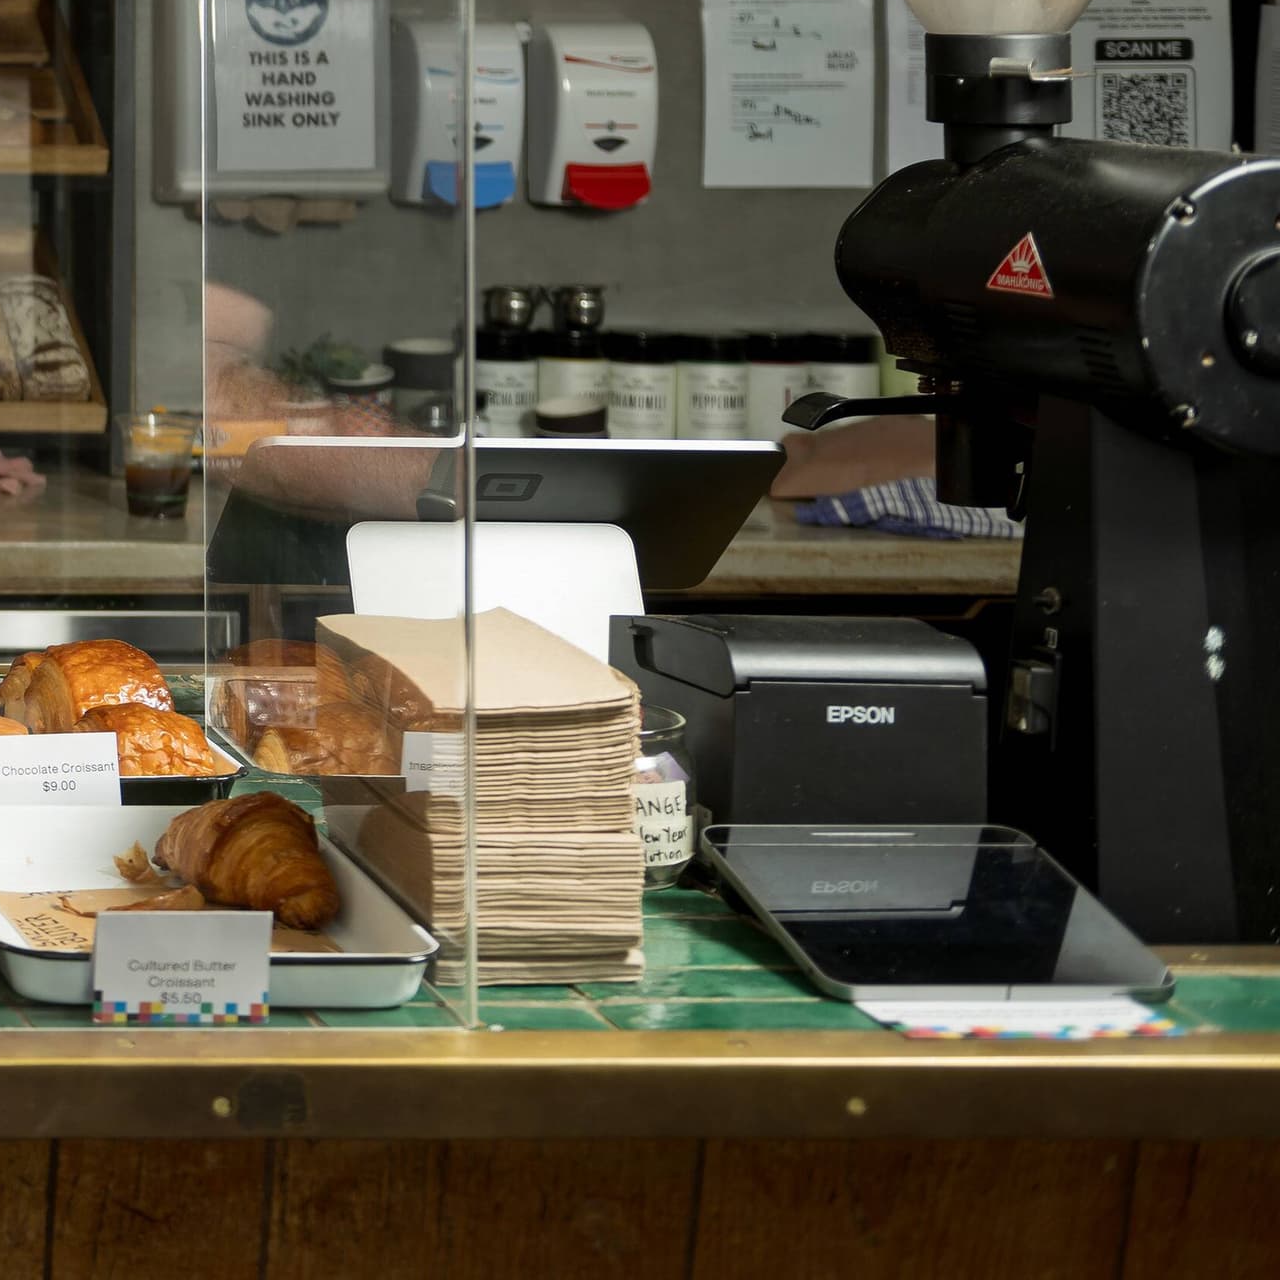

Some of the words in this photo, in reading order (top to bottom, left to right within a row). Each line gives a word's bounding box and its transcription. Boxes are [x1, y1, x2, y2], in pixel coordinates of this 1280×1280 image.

[1104, 41, 1153, 58] SCAN
[1158, 41, 1183, 58] ME
[248, 51, 289, 66] THIS
[294, 51, 311, 66] IS
[315, 51, 330, 66] A
[261, 71, 317, 87] HAND
[244, 90, 336, 107] WASHING
[242, 111, 286, 128] SINK
[291, 111, 341, 128] ONLY
[827, 706, 894, 724] EPSON
[2, 763, 58, 776] Chocolate
[62, 761, 116, 774] Croissant
[42, 779, 77, 793] $9.00
[636, 794, 682, 817] ANGE
[644, 849, 683, 864] lution
[127, 959, 190, 973] Cultured
[192, 959, 237, 972] Butter
[147, 974, 216, 988] Croissant
